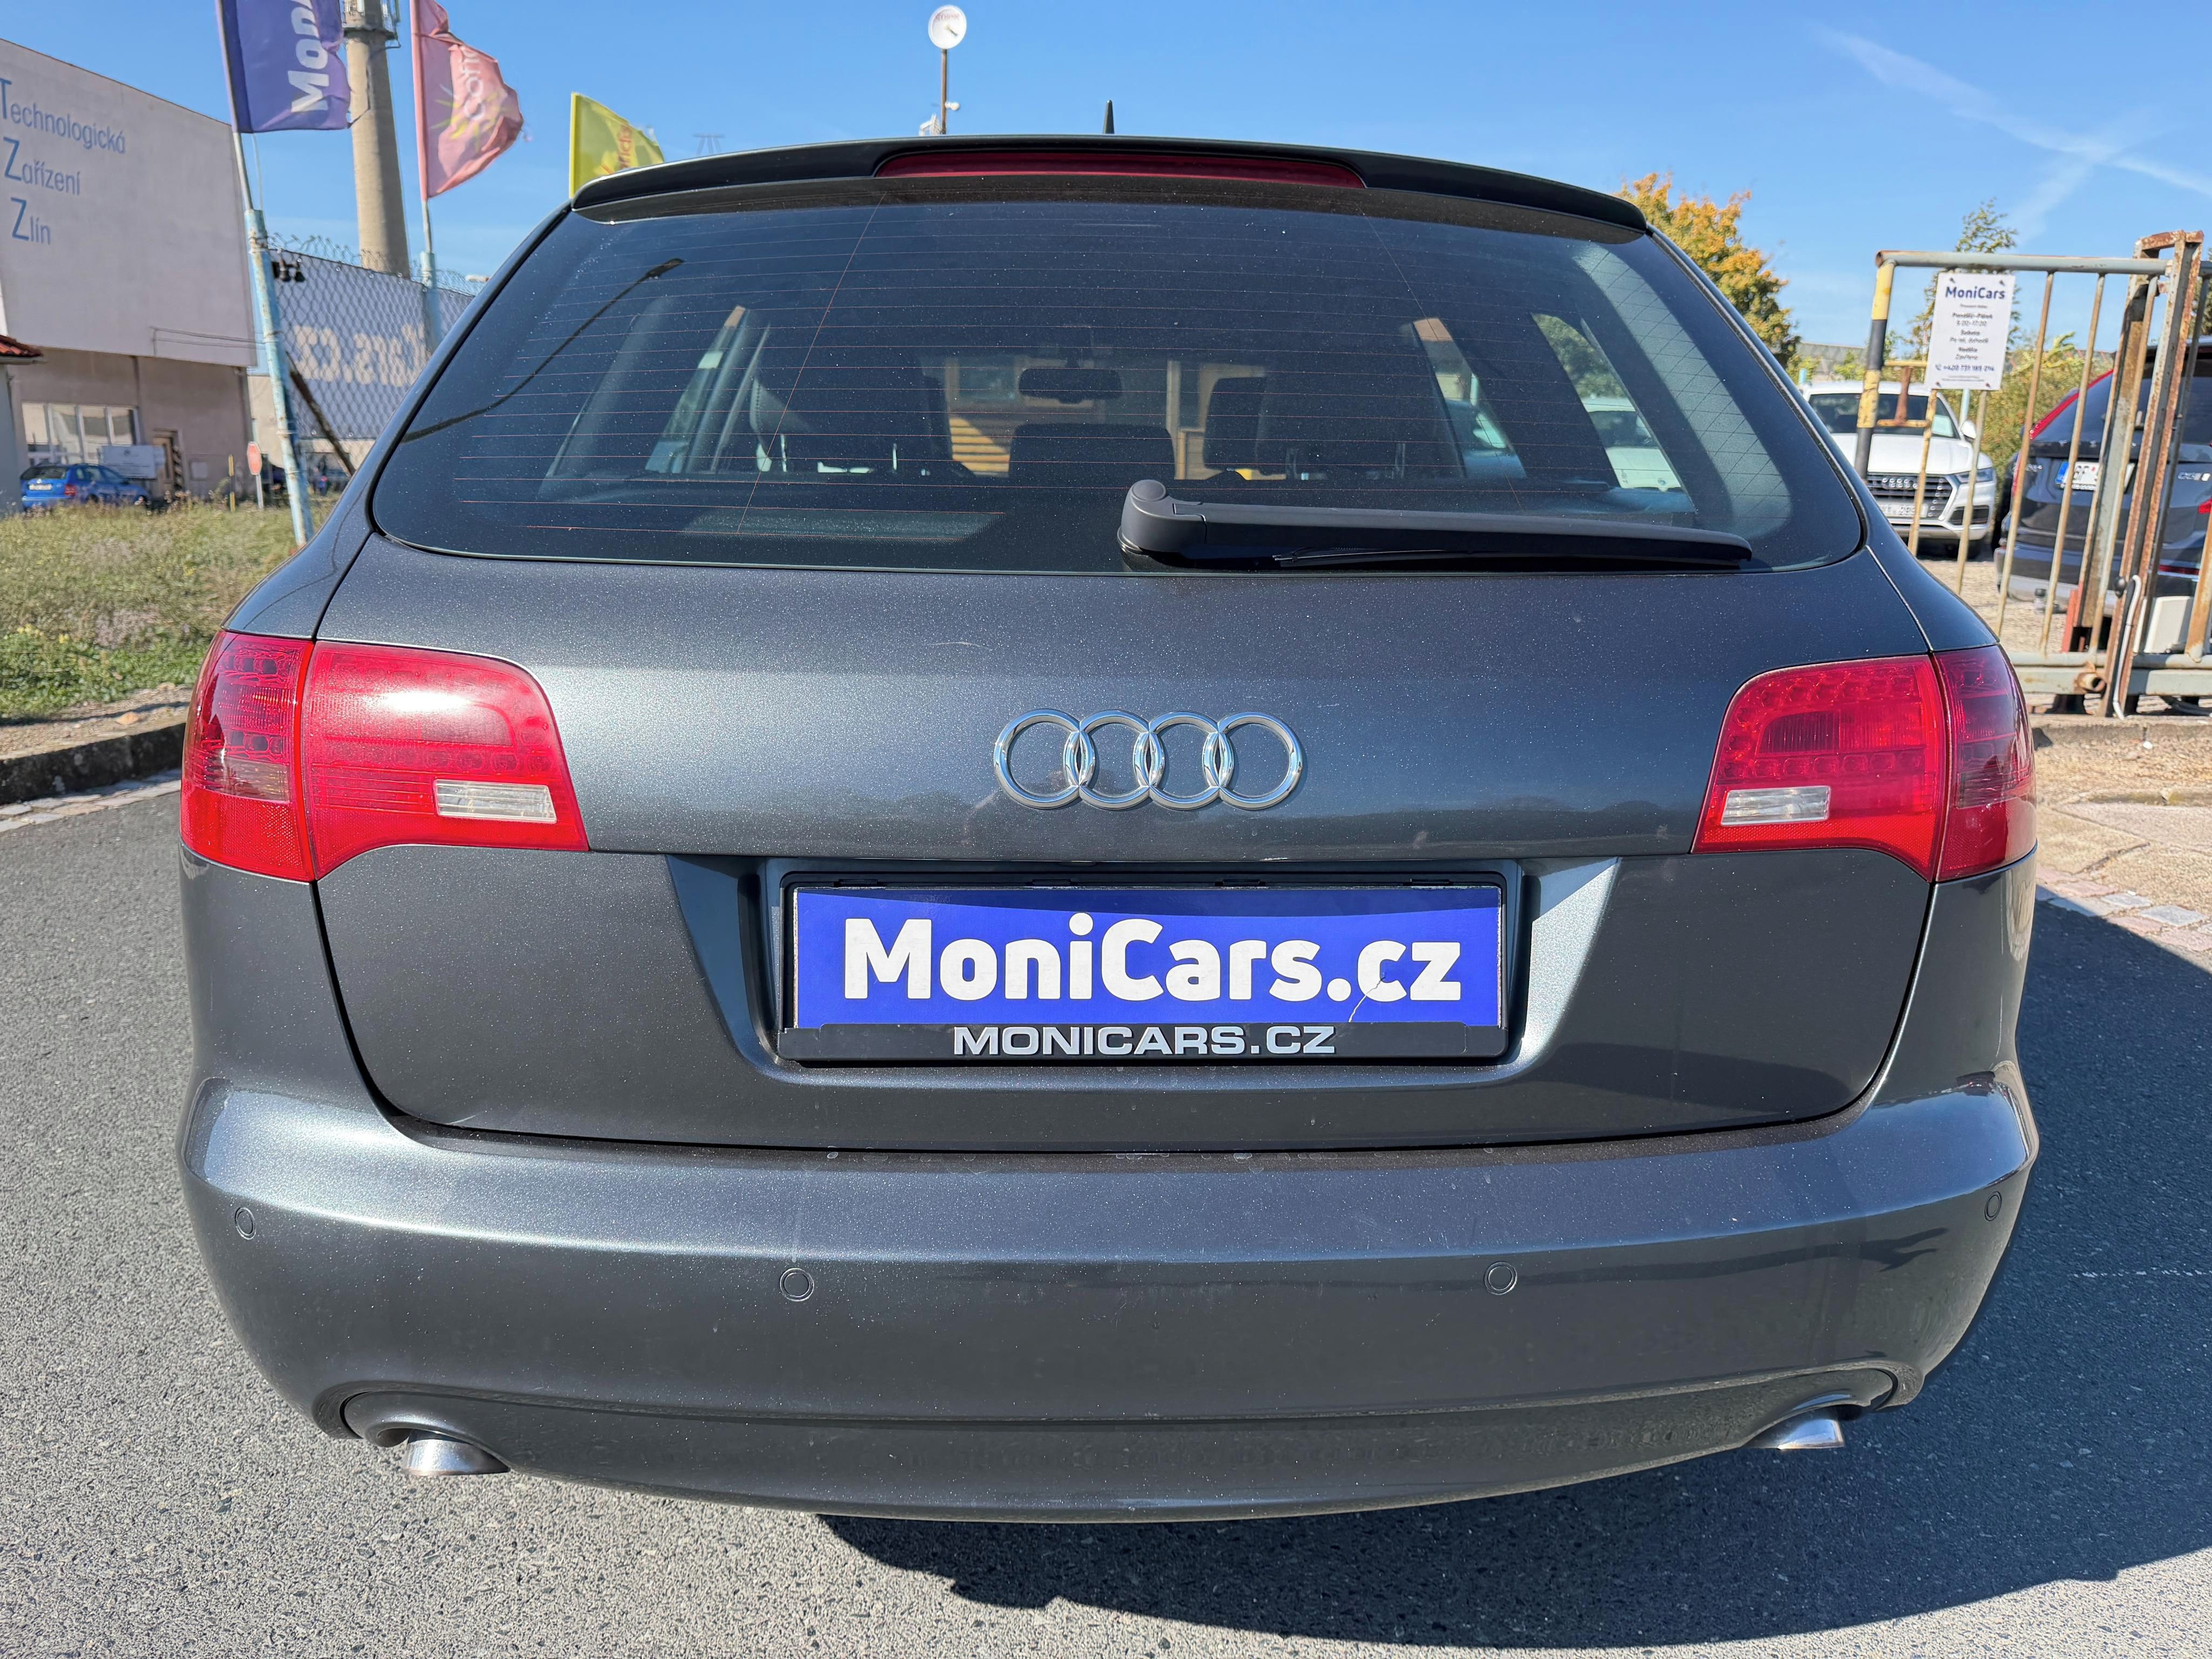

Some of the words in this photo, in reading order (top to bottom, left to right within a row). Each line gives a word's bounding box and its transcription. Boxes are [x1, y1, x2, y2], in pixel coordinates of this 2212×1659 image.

[287, 0, 329, 112] Mon
[0, 78, 126, 154] Technologická
[3, 137, 81, 195] Zařízení
[10, 197, 51, 245] Zlín
[1945, 286, 2006, 300] MoniCars
[844, 912, 1461, 1002] MoniCars.cz
[954, 1026, 1336, 1056] MONICARS.CZ
